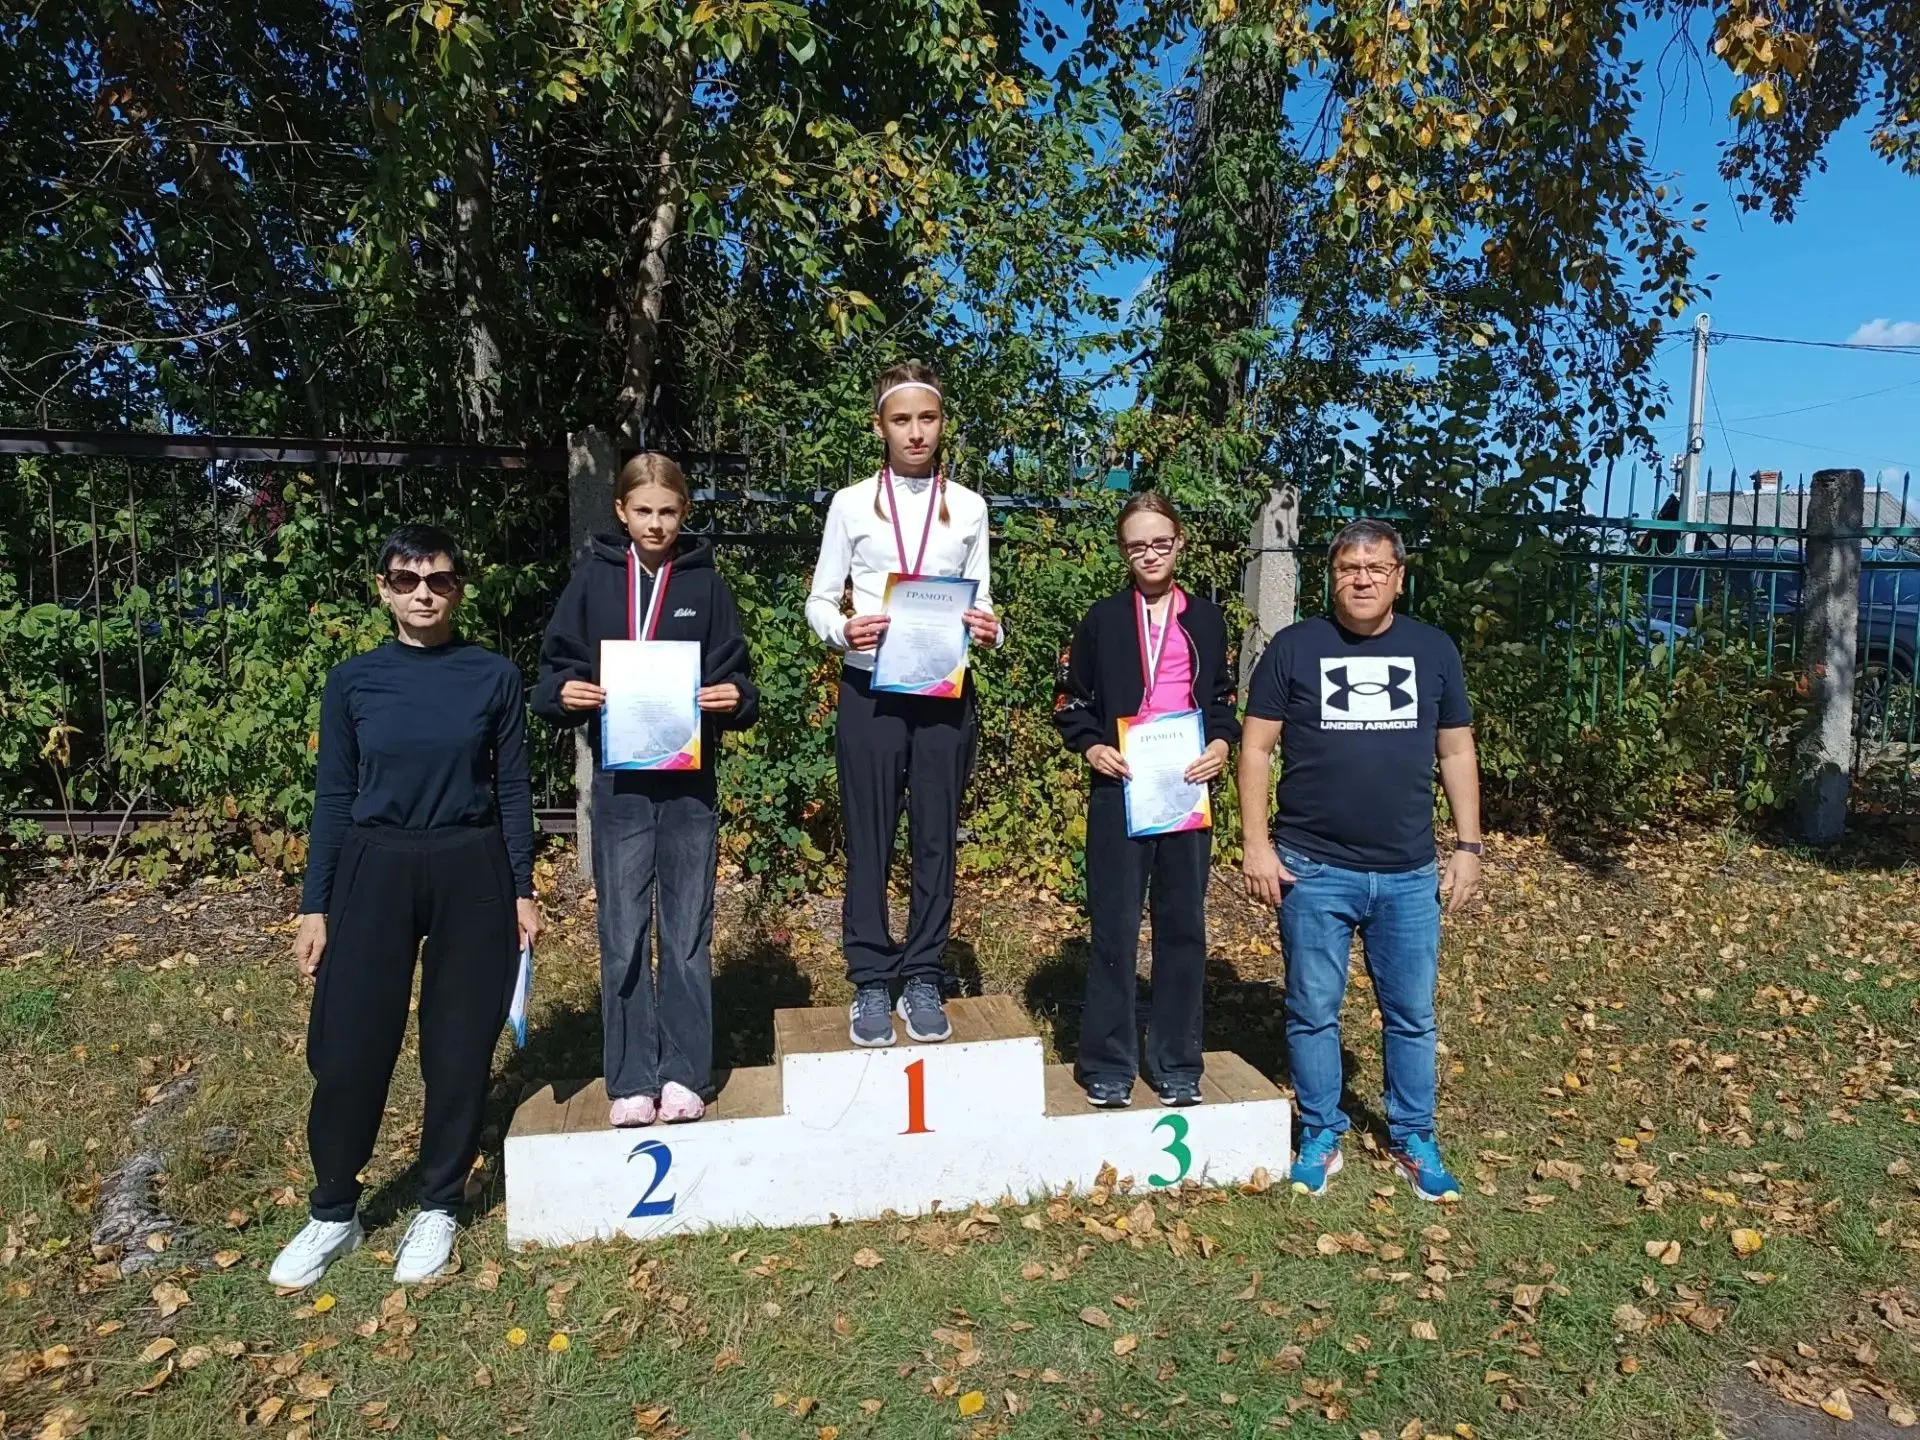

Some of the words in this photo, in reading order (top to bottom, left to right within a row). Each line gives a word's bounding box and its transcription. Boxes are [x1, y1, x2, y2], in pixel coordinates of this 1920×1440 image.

[906, 590, 953, 602] ГРАМОТА
[1320, 720, 1364, 731] UNDER
[1364, 720, 1418, 731] ARMOUR
[897, 1059, 934, 1135] 1
[627, 1139, 676, 1219] 2
[1148, 1114, 1192, 1187] 3
